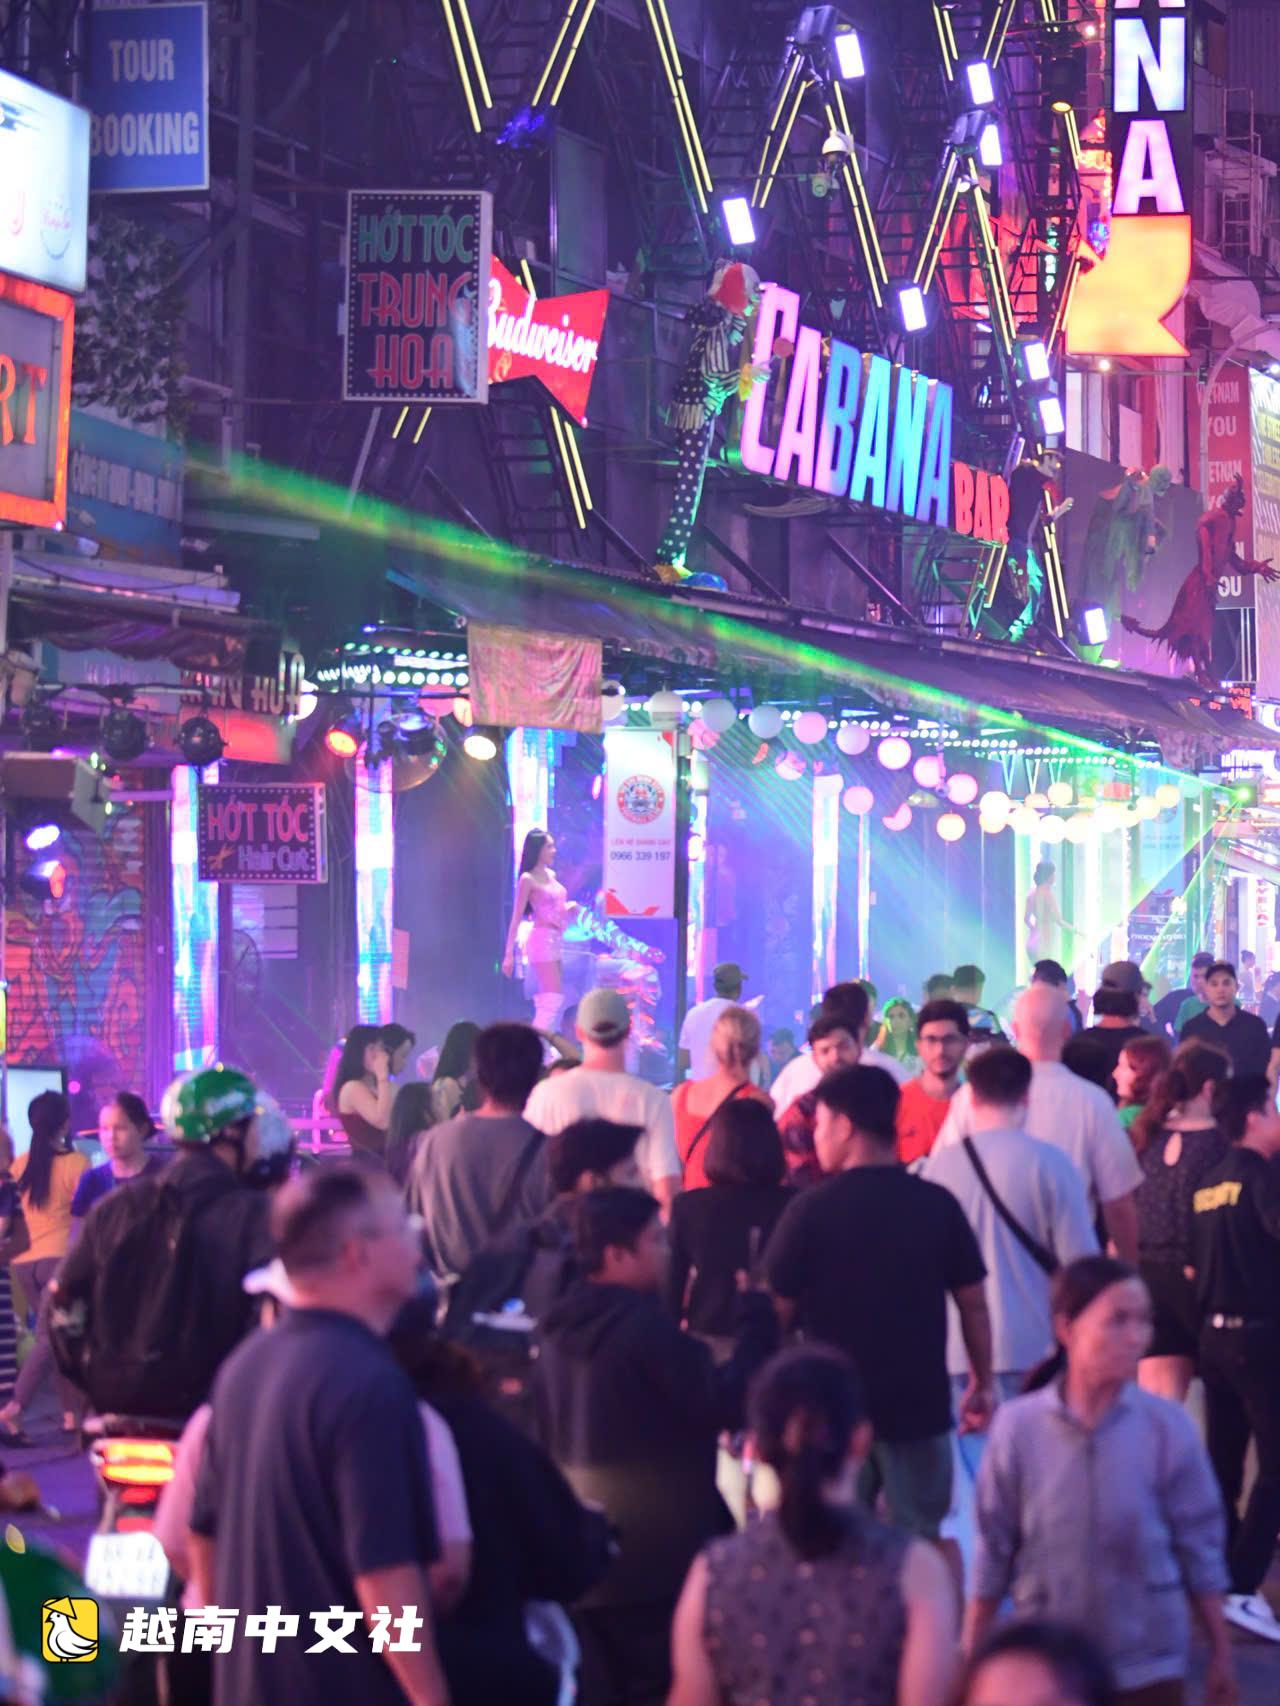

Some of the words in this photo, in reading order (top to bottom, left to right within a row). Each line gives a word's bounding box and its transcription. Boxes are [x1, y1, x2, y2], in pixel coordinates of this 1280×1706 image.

[109, 39, 176, 82] TOUR
[89, 111, 201, 157] BOOKING
[419, 204, 474, 264] TÓC
[488, 277, 598, 373] Budweiser
[740, 281, 954, 528] CABANA
[953, 461, 1010, 545] BAR
[262, 794, 309, 842] TÓC
[238, 843, 276, 871] Hair
[610, 851, 633, 861] 0966
[635, 851, 653, 861] 339
[655, 851, 671, 861] 197
